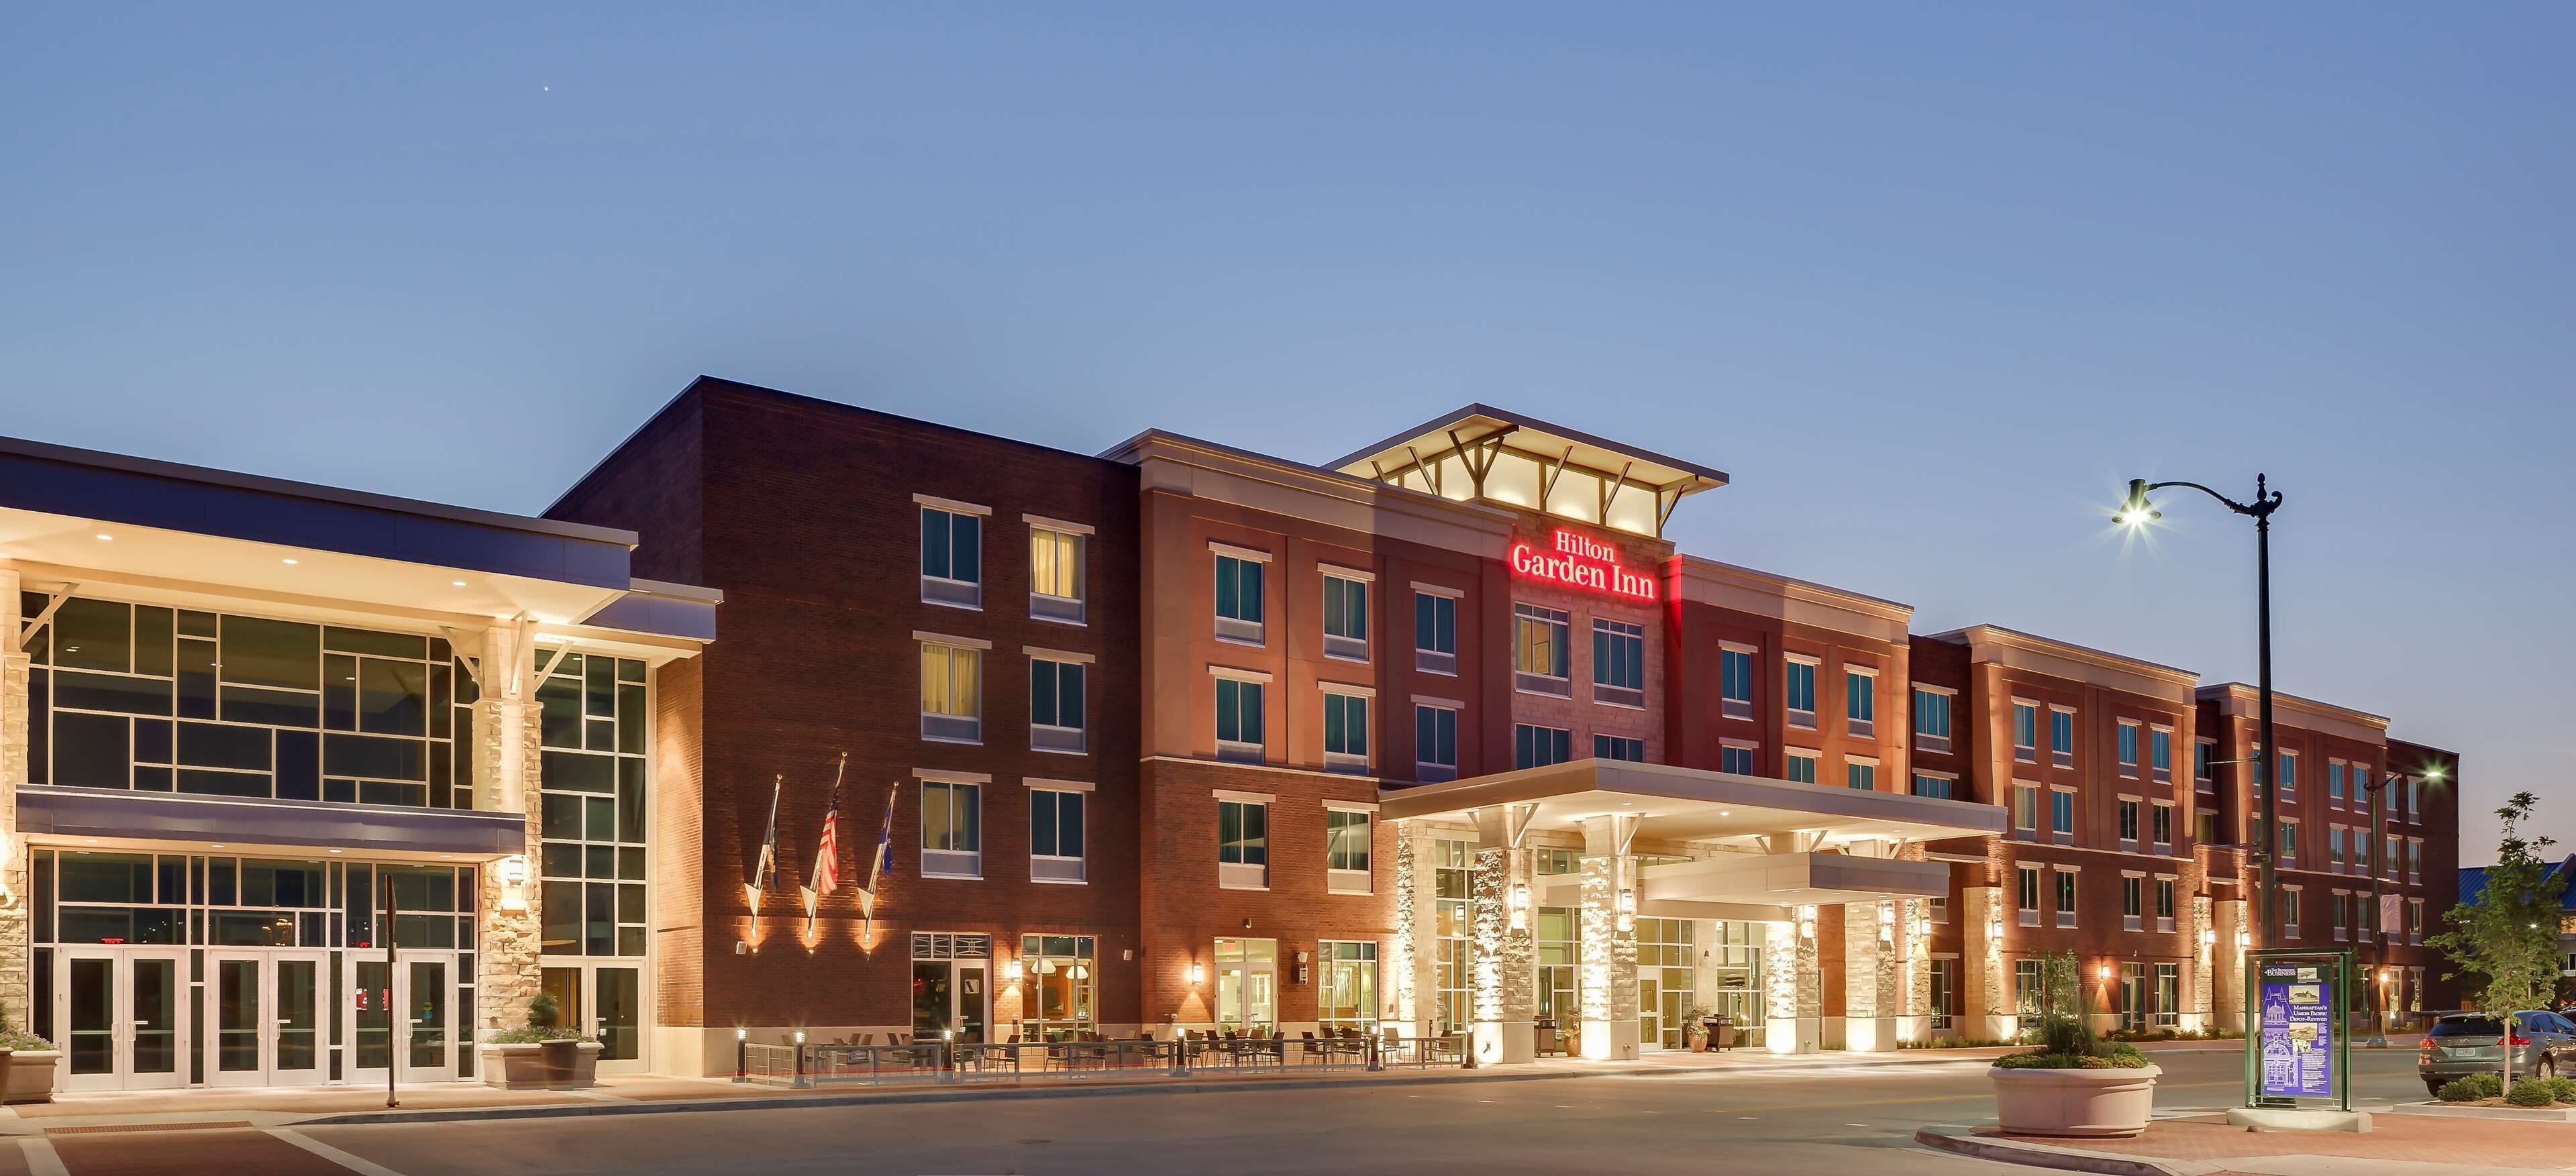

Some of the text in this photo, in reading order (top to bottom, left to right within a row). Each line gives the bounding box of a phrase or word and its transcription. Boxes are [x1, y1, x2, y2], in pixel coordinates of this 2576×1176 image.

[1555, 531, 1615, 563] Hilton
[1512, 544, 1655, 599] Garden Inn
